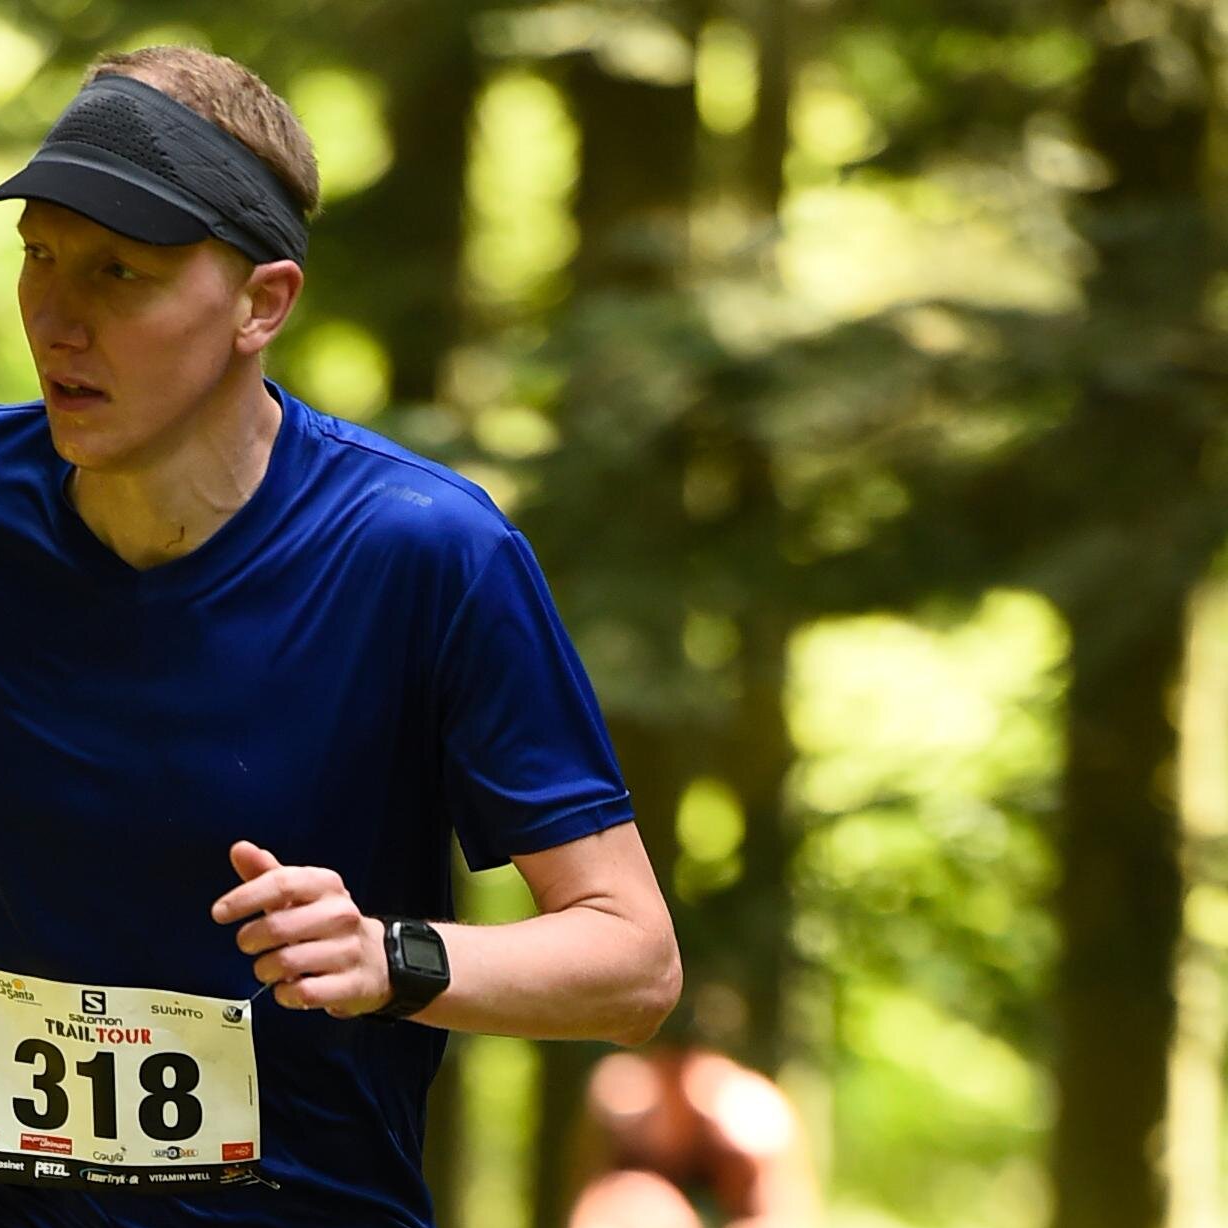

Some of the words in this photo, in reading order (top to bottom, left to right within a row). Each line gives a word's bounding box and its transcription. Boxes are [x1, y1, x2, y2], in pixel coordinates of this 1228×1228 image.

[7, 988, 35, 1001] Santa
[150, 1004, 204, 1020] SUUNTO
[12, 1038, 203, 1142] 318
[34, 1160, 71, 1179] PETZL
[148, 1173, 187, 1183] VITAMIN
[187, 1172, 211, 1182] WELL
